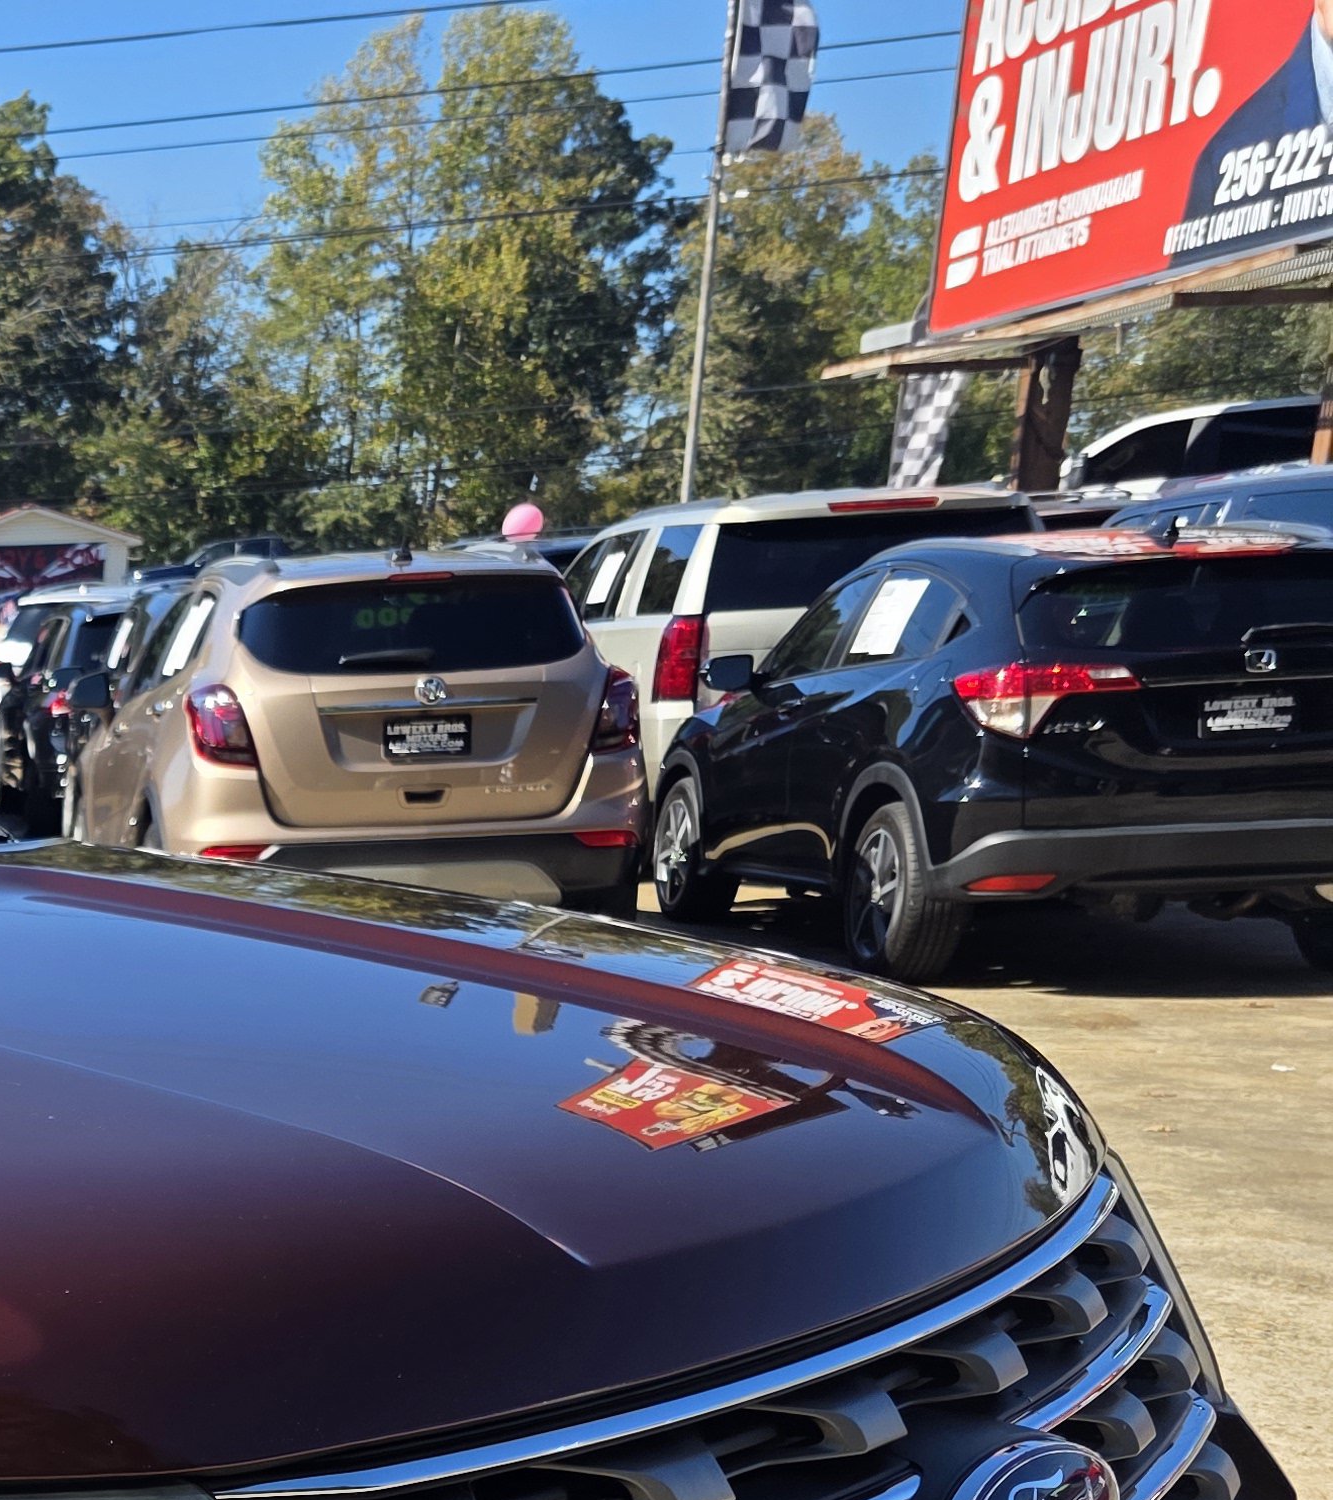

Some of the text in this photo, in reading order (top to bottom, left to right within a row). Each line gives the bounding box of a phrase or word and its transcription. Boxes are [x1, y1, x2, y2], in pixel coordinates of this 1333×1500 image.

[958, 74, 1006, 202] &
[1008, 0, 1221, 185] INJURY.
[1214, 124, 1333, 206] 256-222-
[1163, 216, 1209, 256] OFFICE
[1207, 198, 1274, 245] LOCATION
